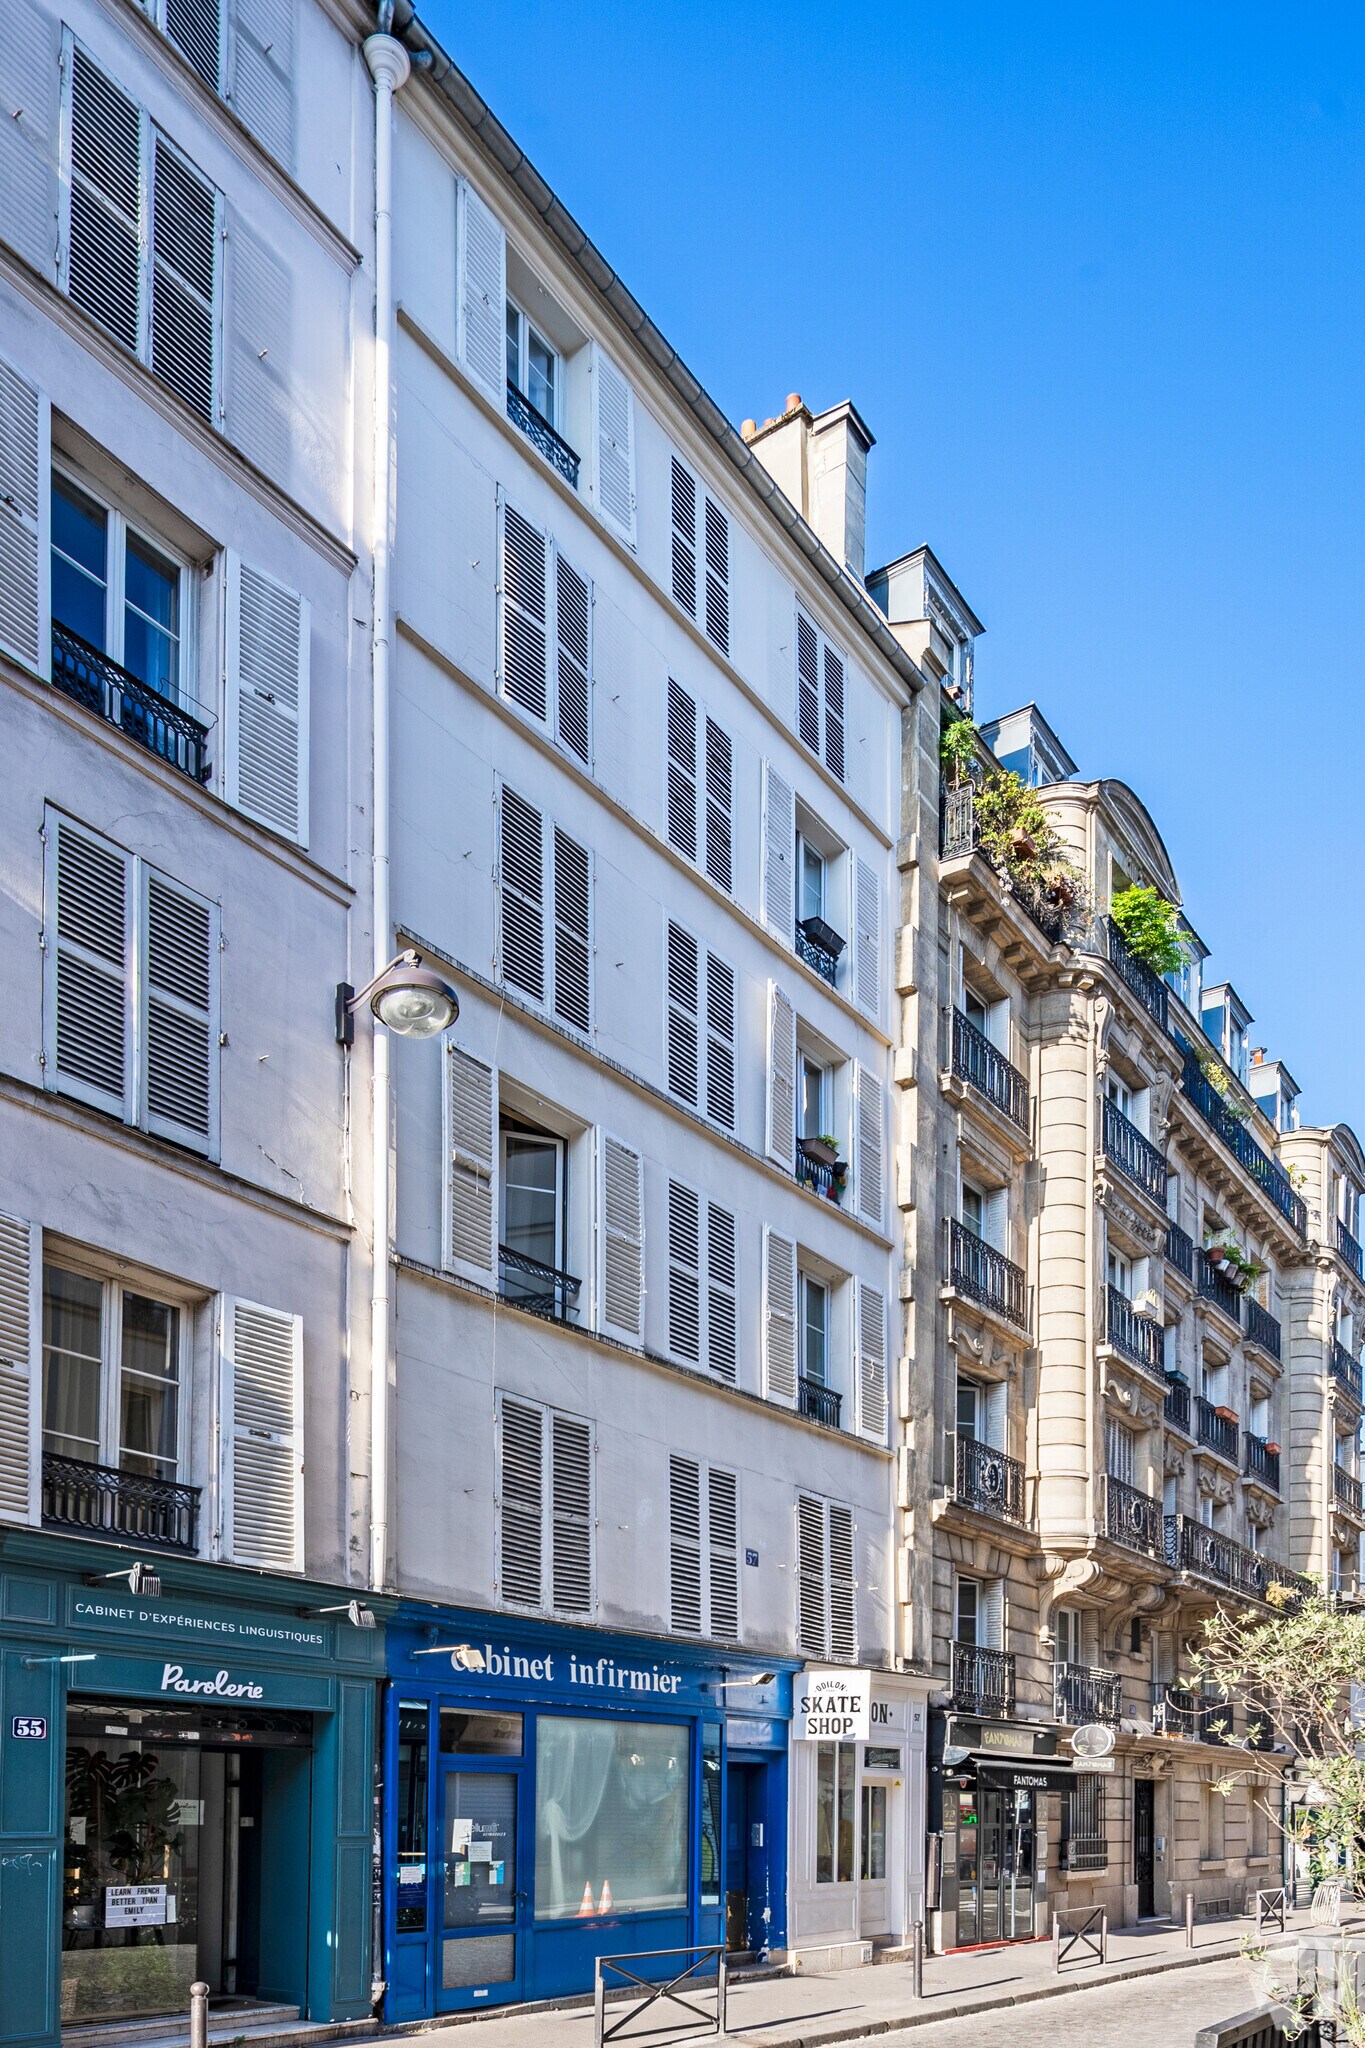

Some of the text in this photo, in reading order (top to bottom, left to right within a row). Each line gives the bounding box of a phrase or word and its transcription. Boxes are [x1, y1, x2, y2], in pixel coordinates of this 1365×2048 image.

[746, 1551, 758, 1565] 57
[75, 1603, 323, 1644] CABINET D'EXPÉRIENCES LINGUISTIQUES
[450, 1643, 682, 1694] cbinet infirmier
[161, 1663, 263, 1699] Parolerie
[815, 1680, 847, 1692] ODILON
[800, 1695, 862, 1714] SKATE
[16, 1719, 42, 1737] 55
[808, 1717, 854, 1735] SHOP
[1013, 1774, 1048, 1787] FANTOMAS
[111, 1887, 160, 1896] LEARN FRENCH
[112, 1897, 158, 1906] BETTER THAN
